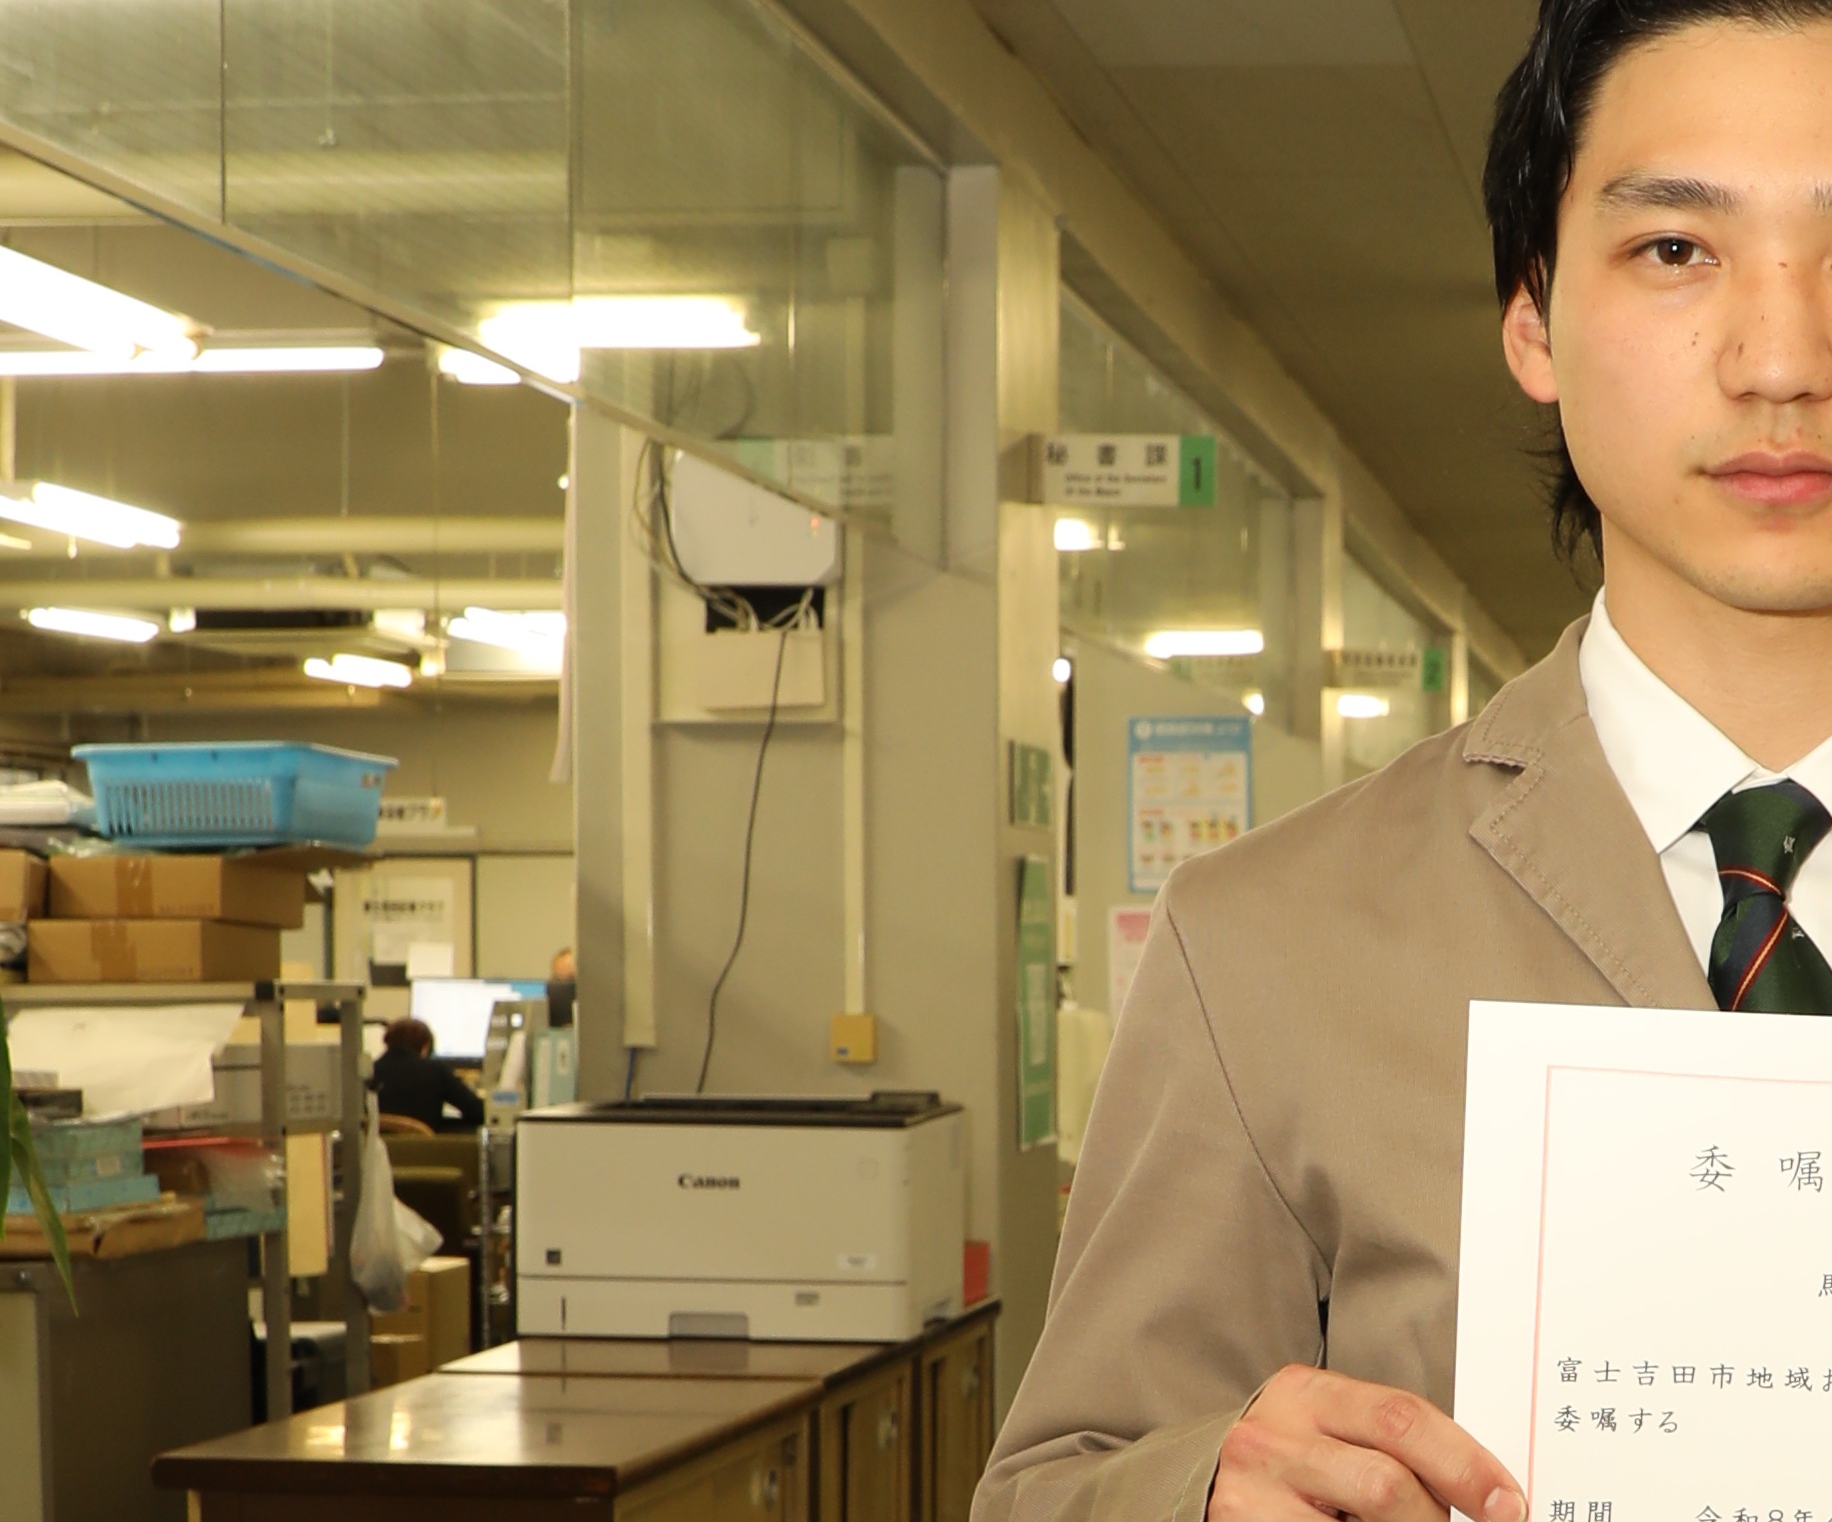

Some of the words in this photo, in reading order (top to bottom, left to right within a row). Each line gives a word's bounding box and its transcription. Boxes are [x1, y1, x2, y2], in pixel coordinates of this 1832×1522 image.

[1192, 456, 1202, 491] 1
[678, 1172, 741, 1191] Canon
[1553, 1404, 1679, 1435] 委嘱する
